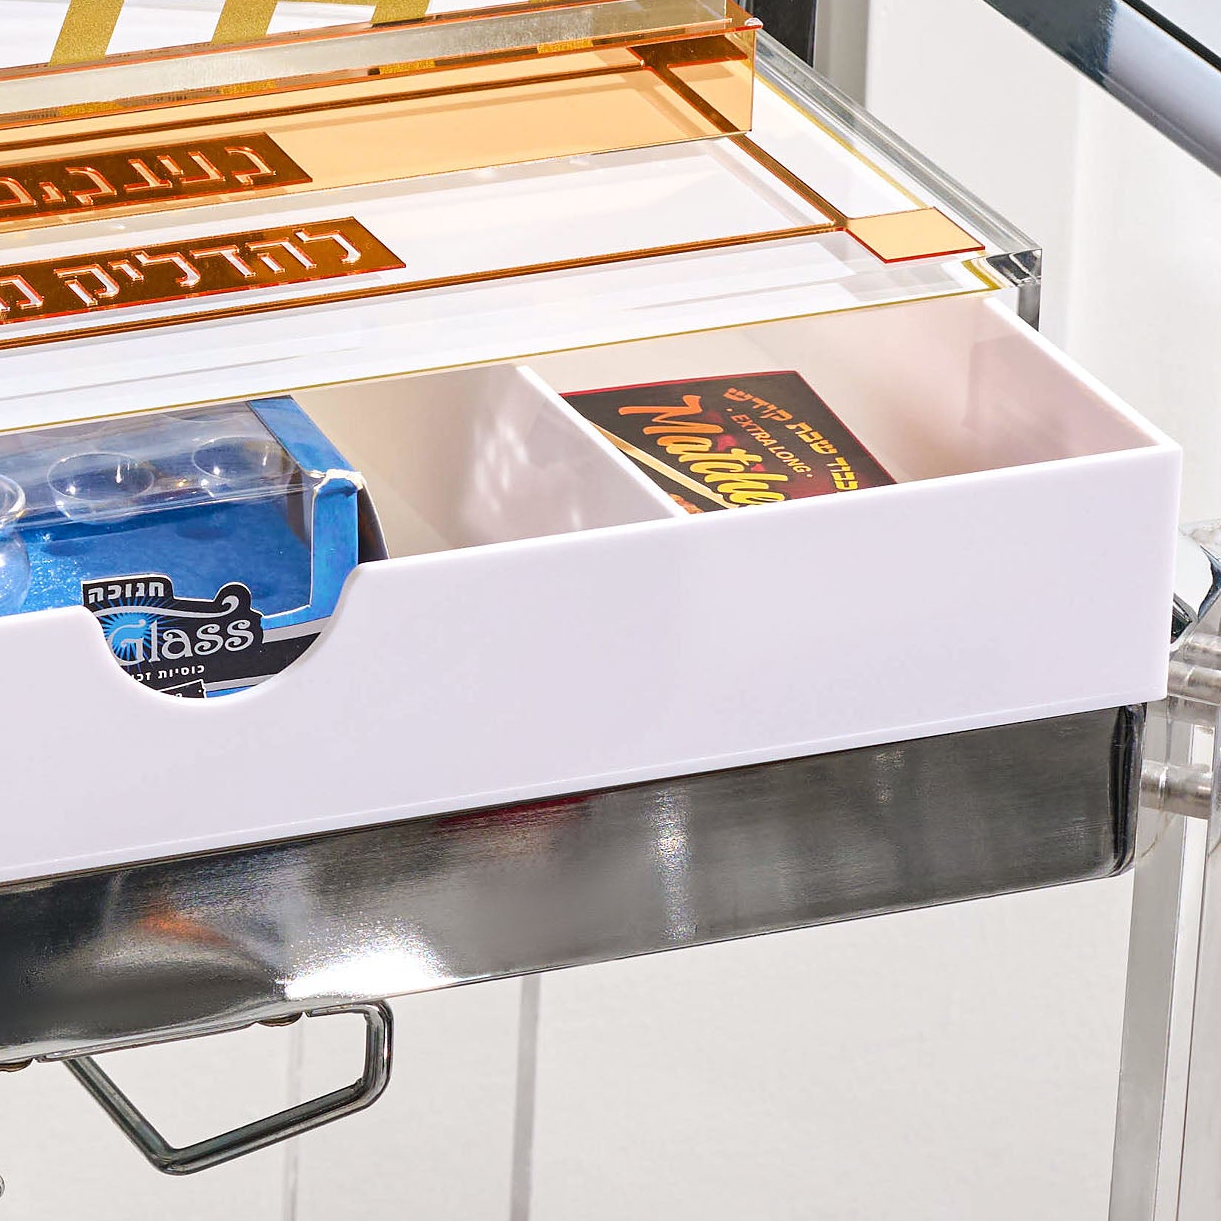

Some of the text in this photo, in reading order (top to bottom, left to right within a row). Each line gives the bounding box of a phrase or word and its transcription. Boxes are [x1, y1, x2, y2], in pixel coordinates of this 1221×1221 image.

[53, 227, 362, 308] להדליק
[618, 394, 789, 506] Matche
[722, 387, 859, 491] כבוד שבת קודש
[731, 413, 812, 474] EXTRA LONG
[87, 581, 165, 604] חנוכה
[106, 618, 255, 667] Glass
[157, 664, 206, 679] כוסיות
